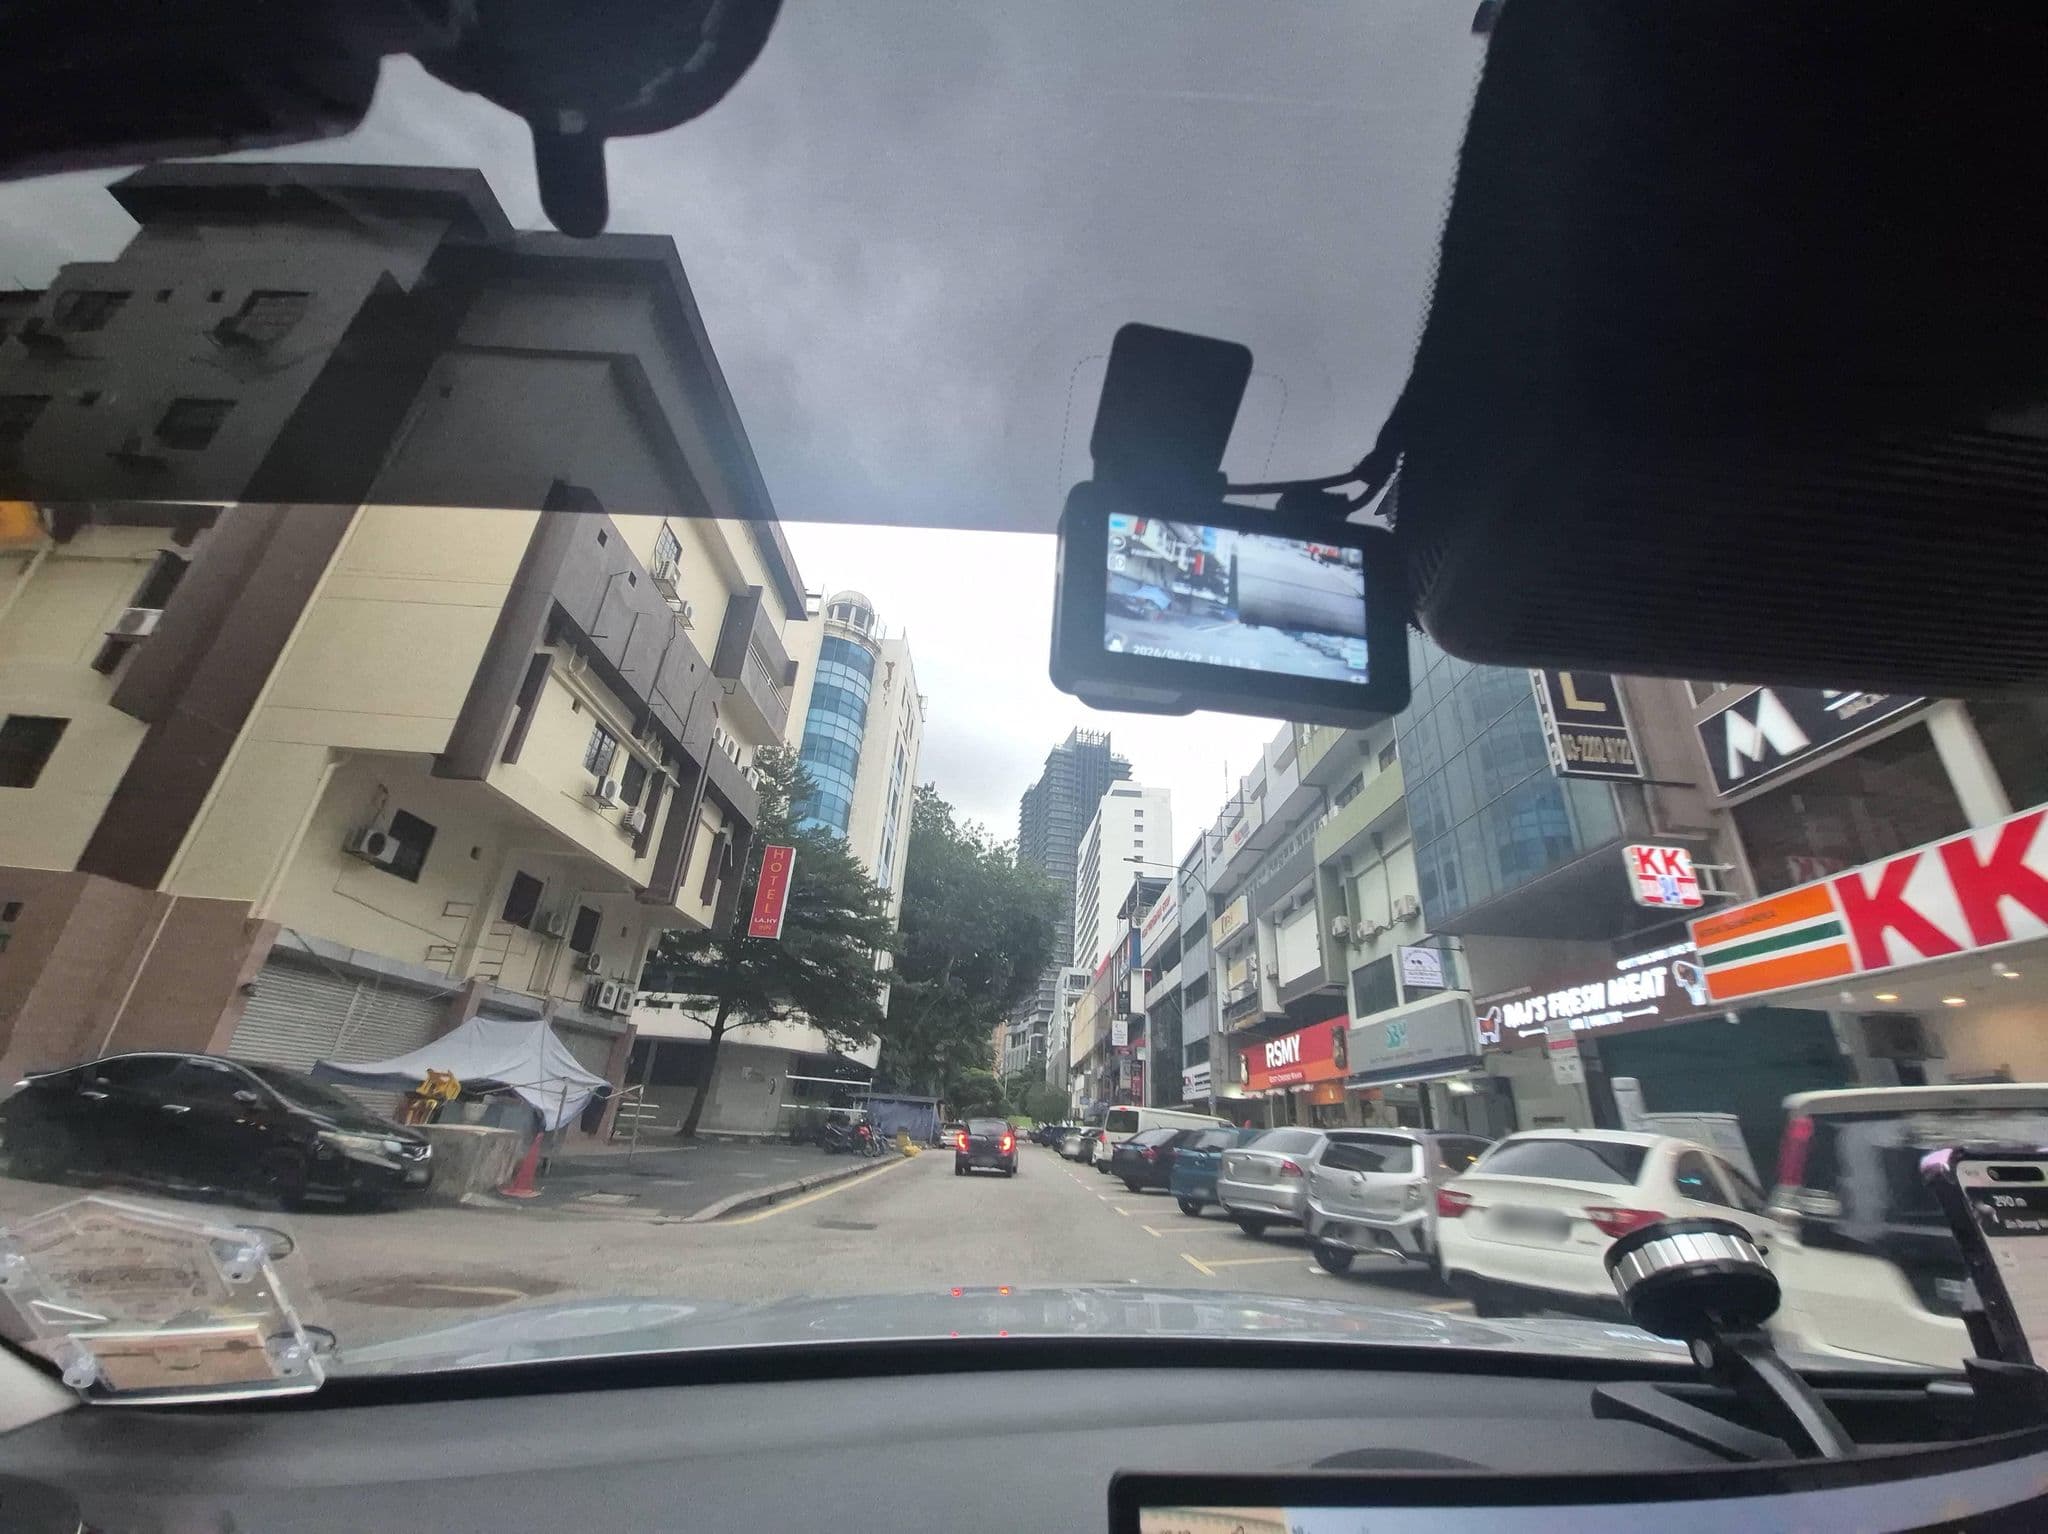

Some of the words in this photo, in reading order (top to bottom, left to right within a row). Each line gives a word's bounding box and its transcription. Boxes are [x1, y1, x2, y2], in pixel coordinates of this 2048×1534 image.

[1725, 686, 1811, 780] M
[766, 849, 785, 913] HOTEL
[1636, 847, 1688, 876] KK
[1834, 808, 2048, 970] KK
[1547, 982, 1606, 1019] FRESH
[1607, 966, 1668, 1007] MEAT
[1265, 1034, 1301, 1069] RSMY
